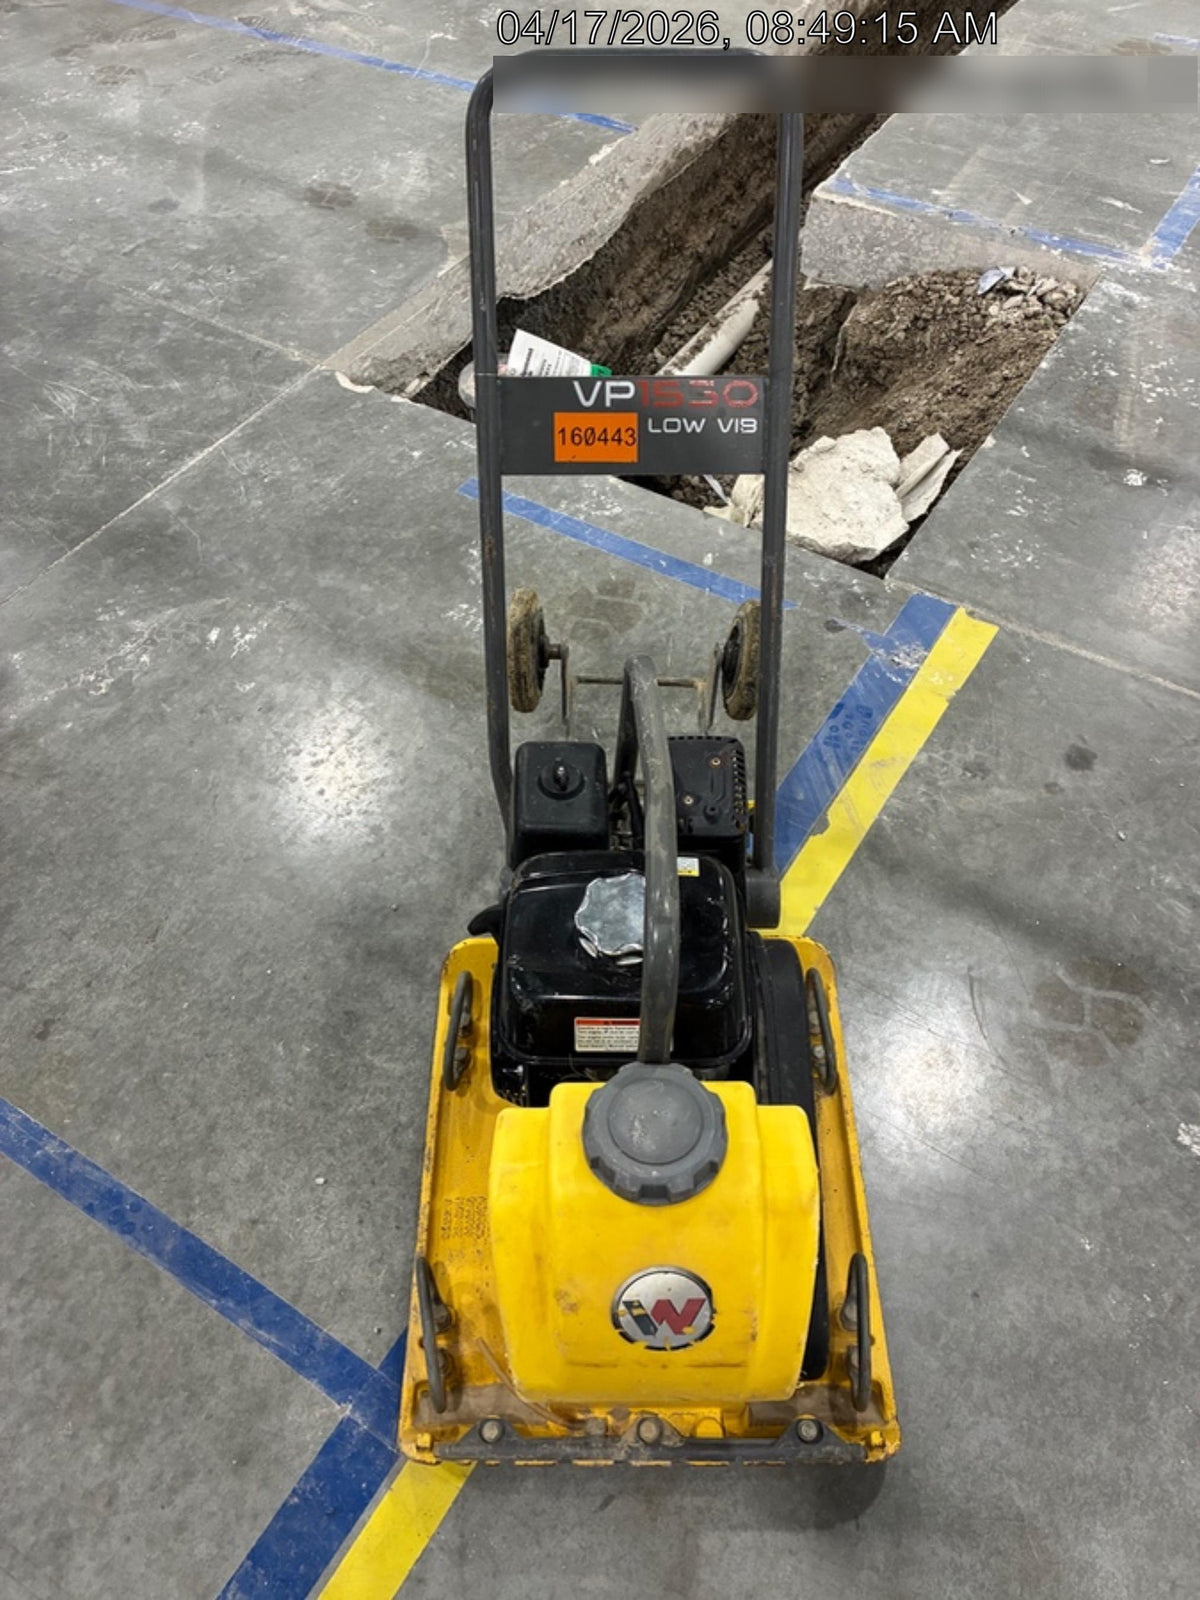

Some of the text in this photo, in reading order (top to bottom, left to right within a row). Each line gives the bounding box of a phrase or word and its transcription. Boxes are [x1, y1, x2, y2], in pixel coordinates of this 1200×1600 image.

[572, 379, 759, 408] VP1530
[648, 417, 706, 434] LOW
[558, 426, 636, 447] 160443
